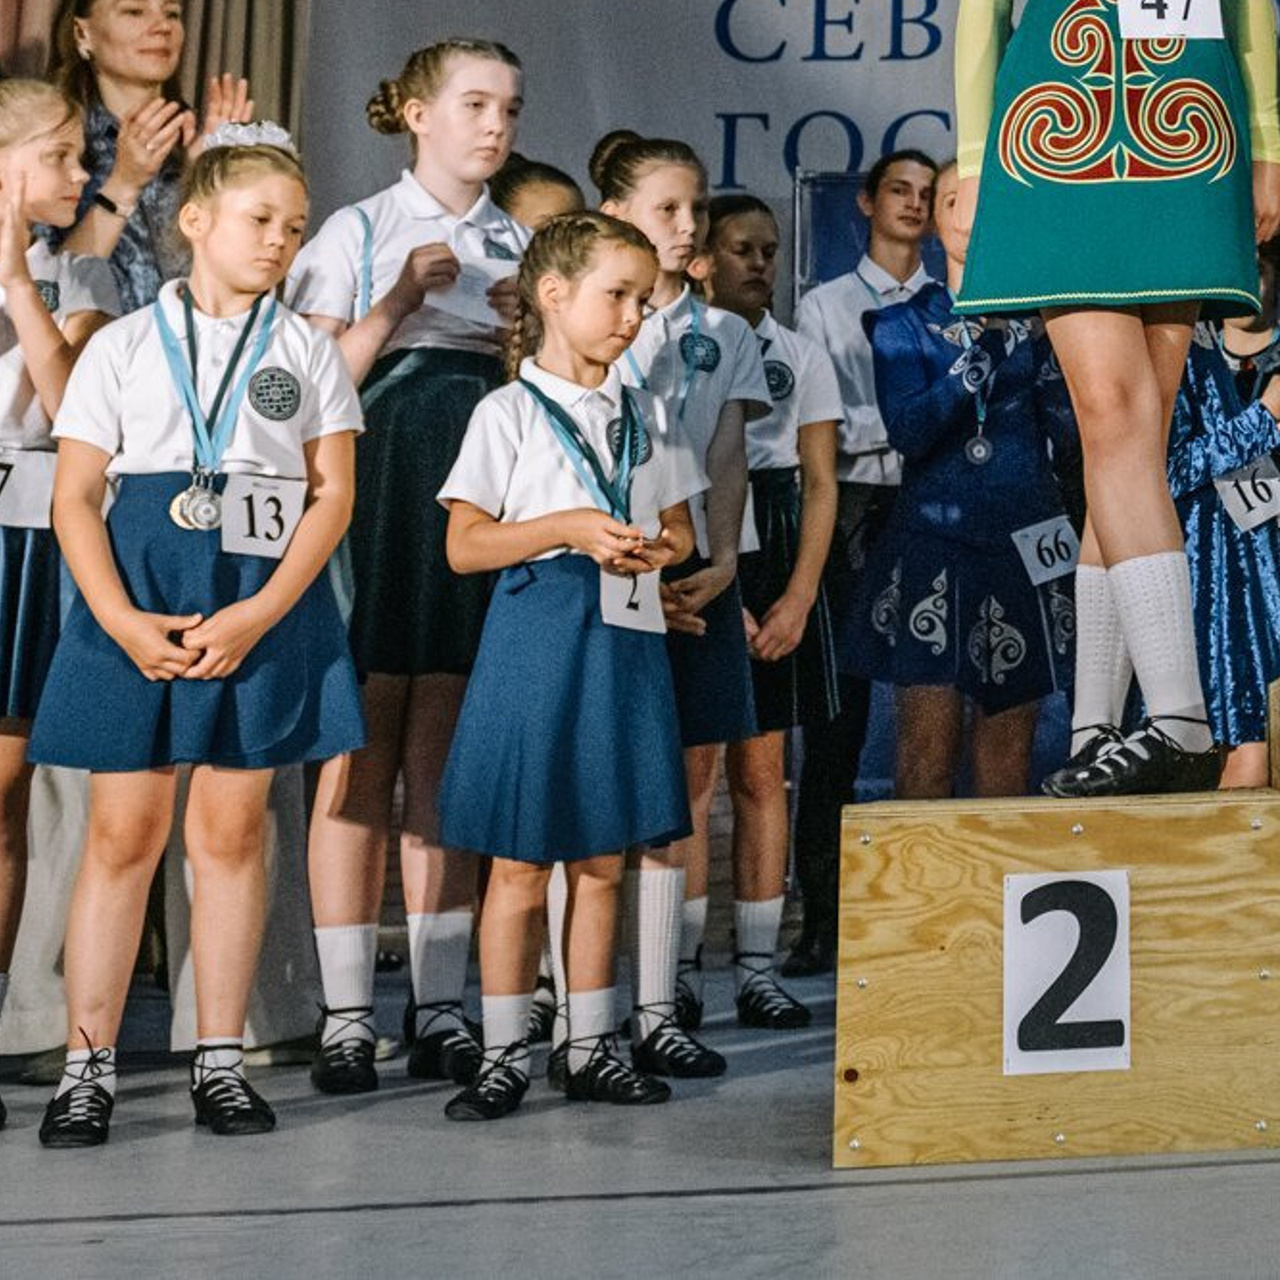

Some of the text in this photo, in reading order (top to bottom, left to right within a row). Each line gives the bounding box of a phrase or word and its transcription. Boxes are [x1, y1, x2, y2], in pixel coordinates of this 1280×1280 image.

[1231, 467, 1273, 513] 16
[242, 493, 285, 542] 13
[1036, 528, 1072, 568] 66
[1017, 880, 1125, 1052] 2
